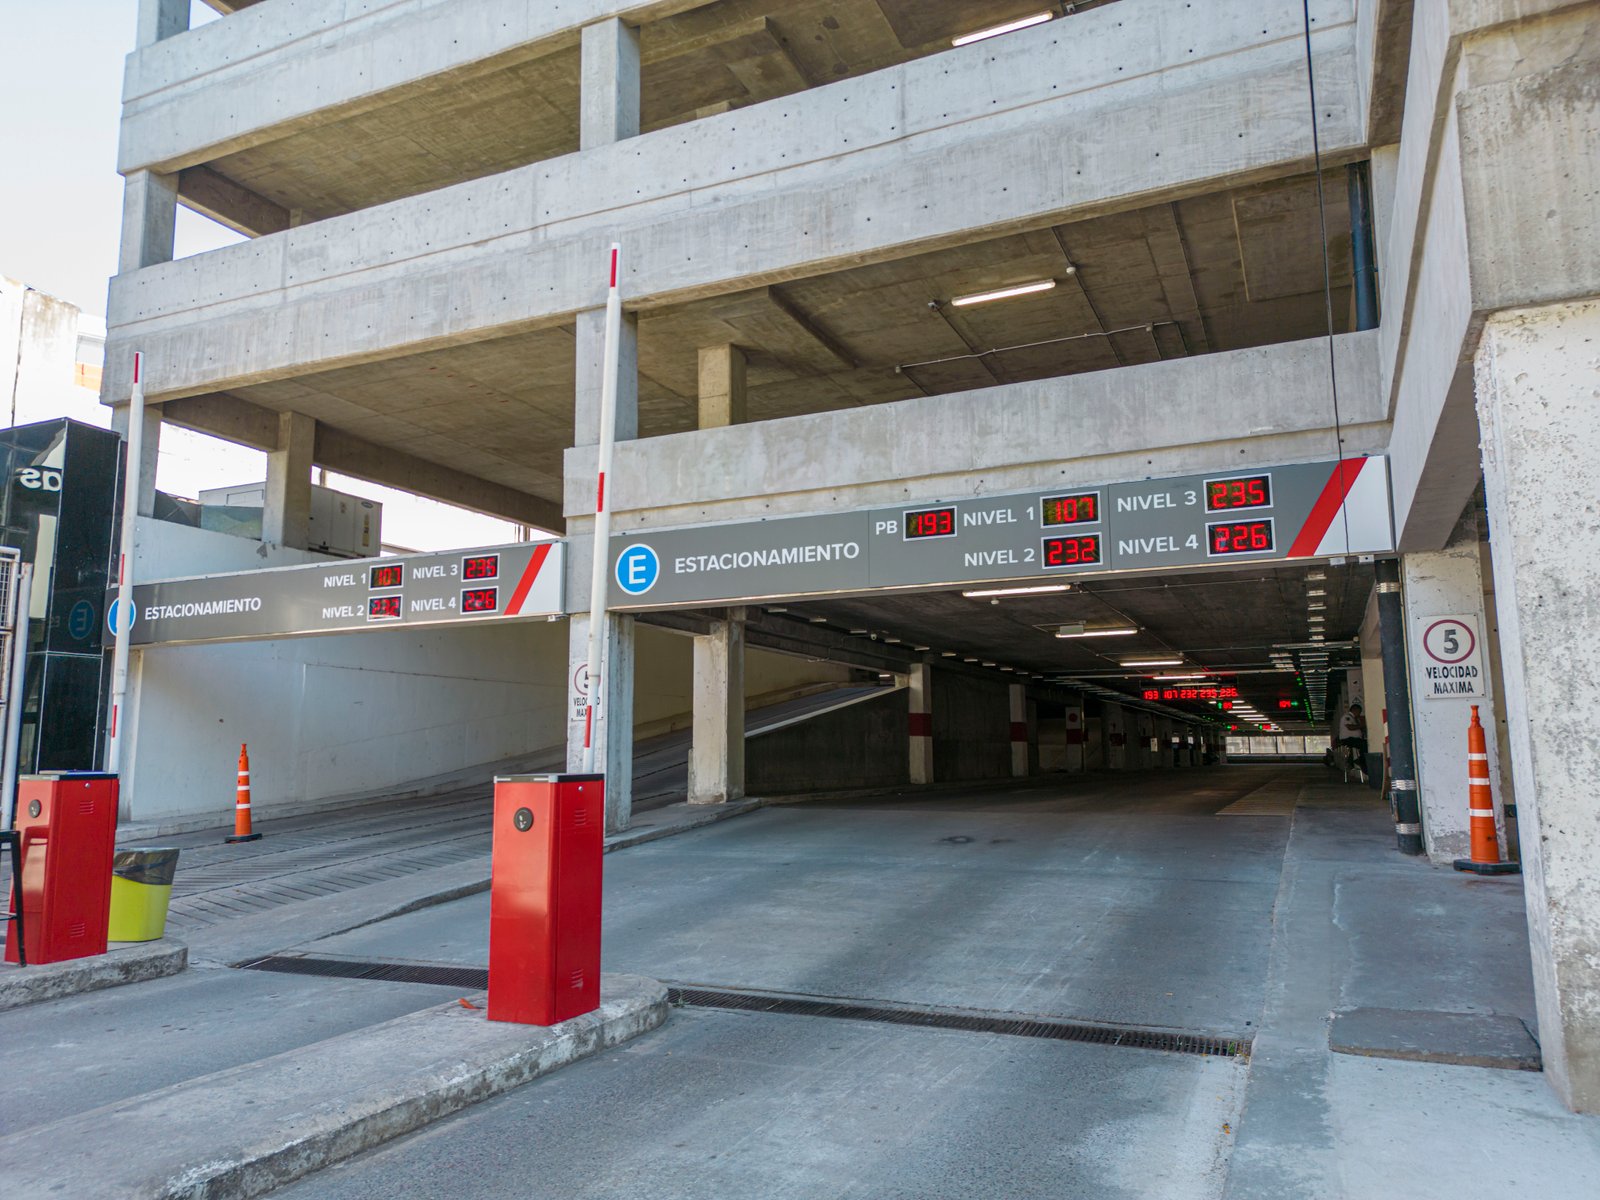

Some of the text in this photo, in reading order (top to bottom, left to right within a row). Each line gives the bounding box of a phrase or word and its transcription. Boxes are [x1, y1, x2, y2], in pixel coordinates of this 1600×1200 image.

[1117, 490, 1197, 512] NIVEL 3
[1212, 479, 1265, 508] 235
[963, 506, 1035, 527] NIVEL 1
[1055, 497, 1094, 523] 107
[875, 520, 898, 535] PB
[917, 511, 952, 535] 193
[1118, 533, 1199, 555] NIVEL 4
[1215, 523, 1267, 552] 226
[964, 548, 1035, 567] NIVEL 2
[1048, 538, 1096, 565] 232
[412, 565, 458, 580] NIVEL 3
[465, 557, 496, 579] 235
[628, 542, 860, 585] E ESTACIONAMIENTO
[323, 573, 366, 588] NIVEL 1
[377, 567, 401, 586] 107
[145, 597, 262, 620] ESTACIONAMIENTO
[322, 604, 364, 619] NIVEL 2
[371, 598, 400, 618] 232
[411, 597, 457, 612] NIVEL 4
[464, 591, 495, 612] 226
[1443, 629, 1459, 654] 5
[1426, 665, 1478, 679] VELOCIDAD
[1143, 690, 1159, 700] 193
[1163, 690, 1178, 699] 107
[1180, 689, 1197, 699] 232
[1433, 681, 1474, 694] MAXIMA
